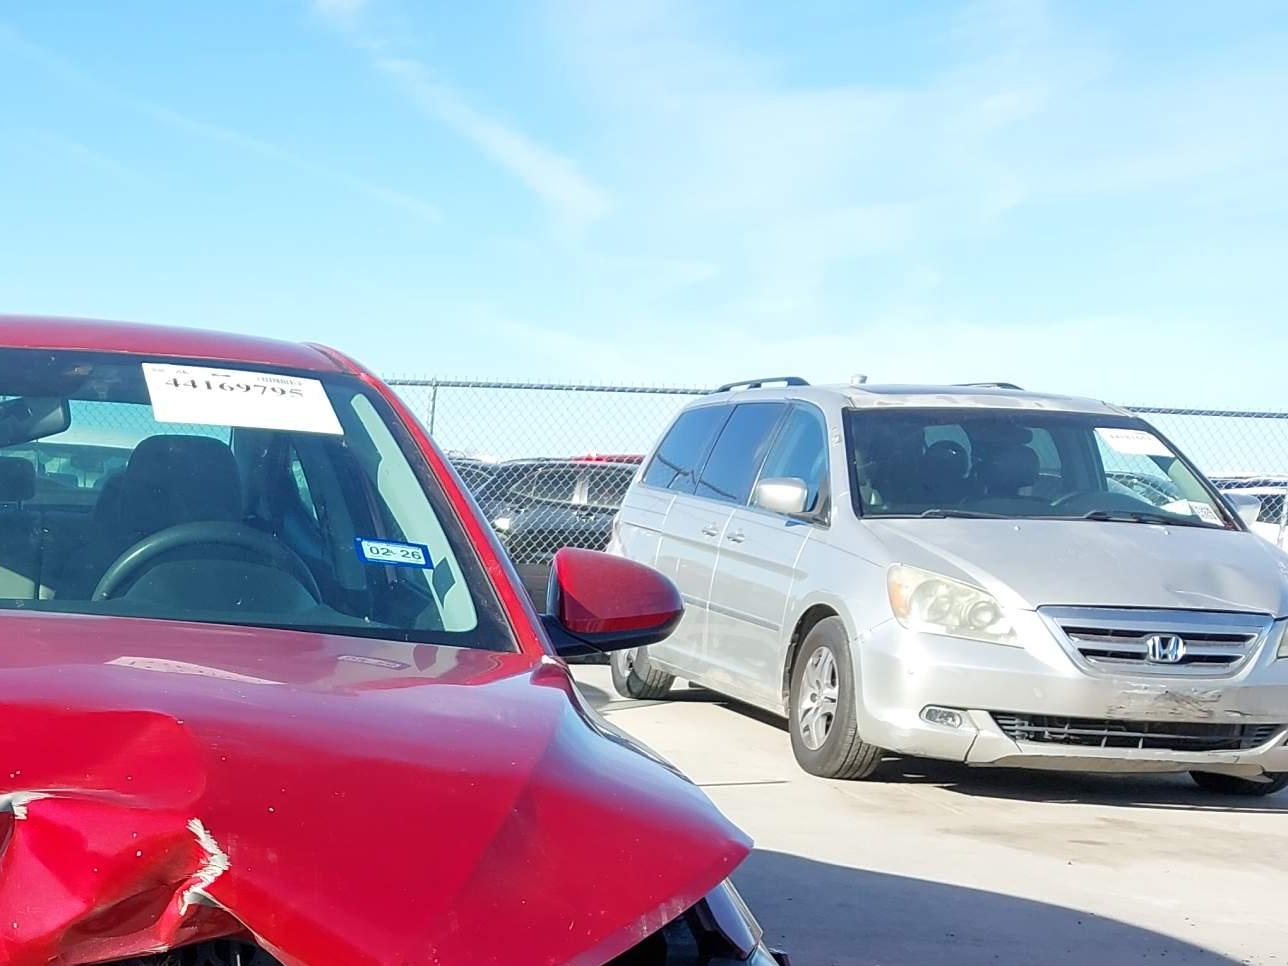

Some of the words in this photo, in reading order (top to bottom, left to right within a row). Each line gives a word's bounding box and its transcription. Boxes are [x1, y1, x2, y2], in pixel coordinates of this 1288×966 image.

[165, 377, 304, 398] 44169795
[369, 546, 392, 556] 02
[399, 549, 422, 560] 26
